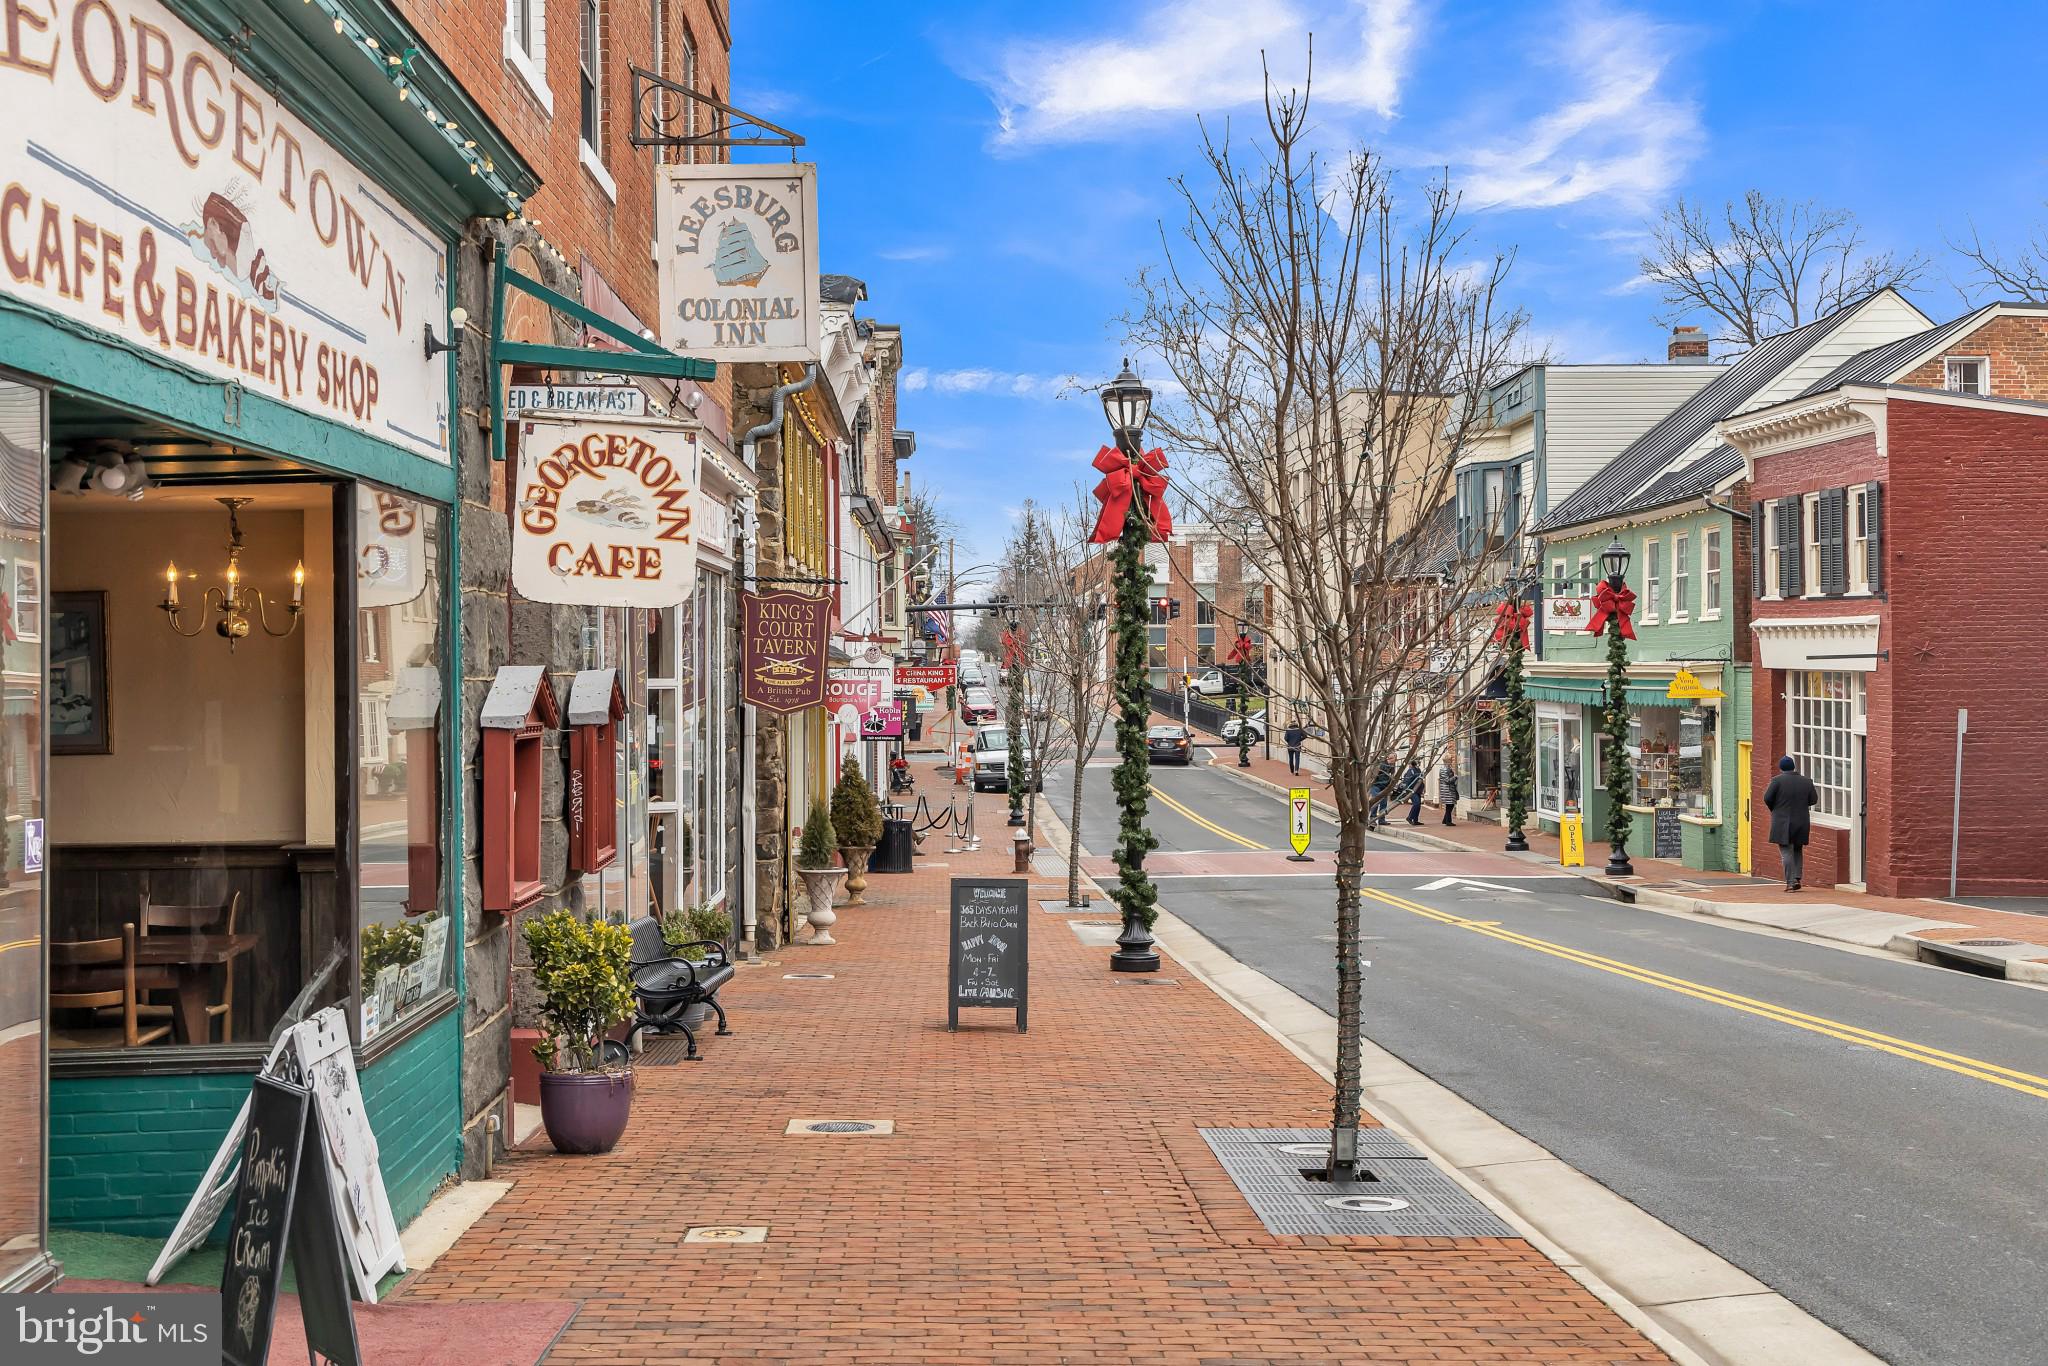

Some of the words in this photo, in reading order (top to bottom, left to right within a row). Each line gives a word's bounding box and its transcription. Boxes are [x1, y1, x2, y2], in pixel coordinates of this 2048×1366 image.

[676, 184, 800, 255] LEESBURG
[1, 182, 126, 322] CAFE
[134, 226, 171, 351] &
[175, 265, 308, 400] BAKERY
[316, 340, 380, 423] SHOP
[677, 297, 800, 323] COLONIAL
[713, 322, 767, 345] INN
[521, 432, 691, 545] GEORGETOWN
[548, 542, 663, 581] CAFE
[760, 603, 814, 620] KING'S
[758, 620, 815, 638] COURT
[753, 637, 817, 656] TAVERN
[757, 686, 764, 694] A
[767, 686, 793, 695] British
[795, 687, 811, 695] Pub
[888, 714, 901, 722] Lee
[1568, 824, 1577, 852] OPEN
[960, 905, 974, 914] 365
[975, 905, 992, 915] DAYS
[992, 906, 998, 915] A
[961, 934, 985, 951] HAPPY
[246, 1199, 270, 1227] Ice
